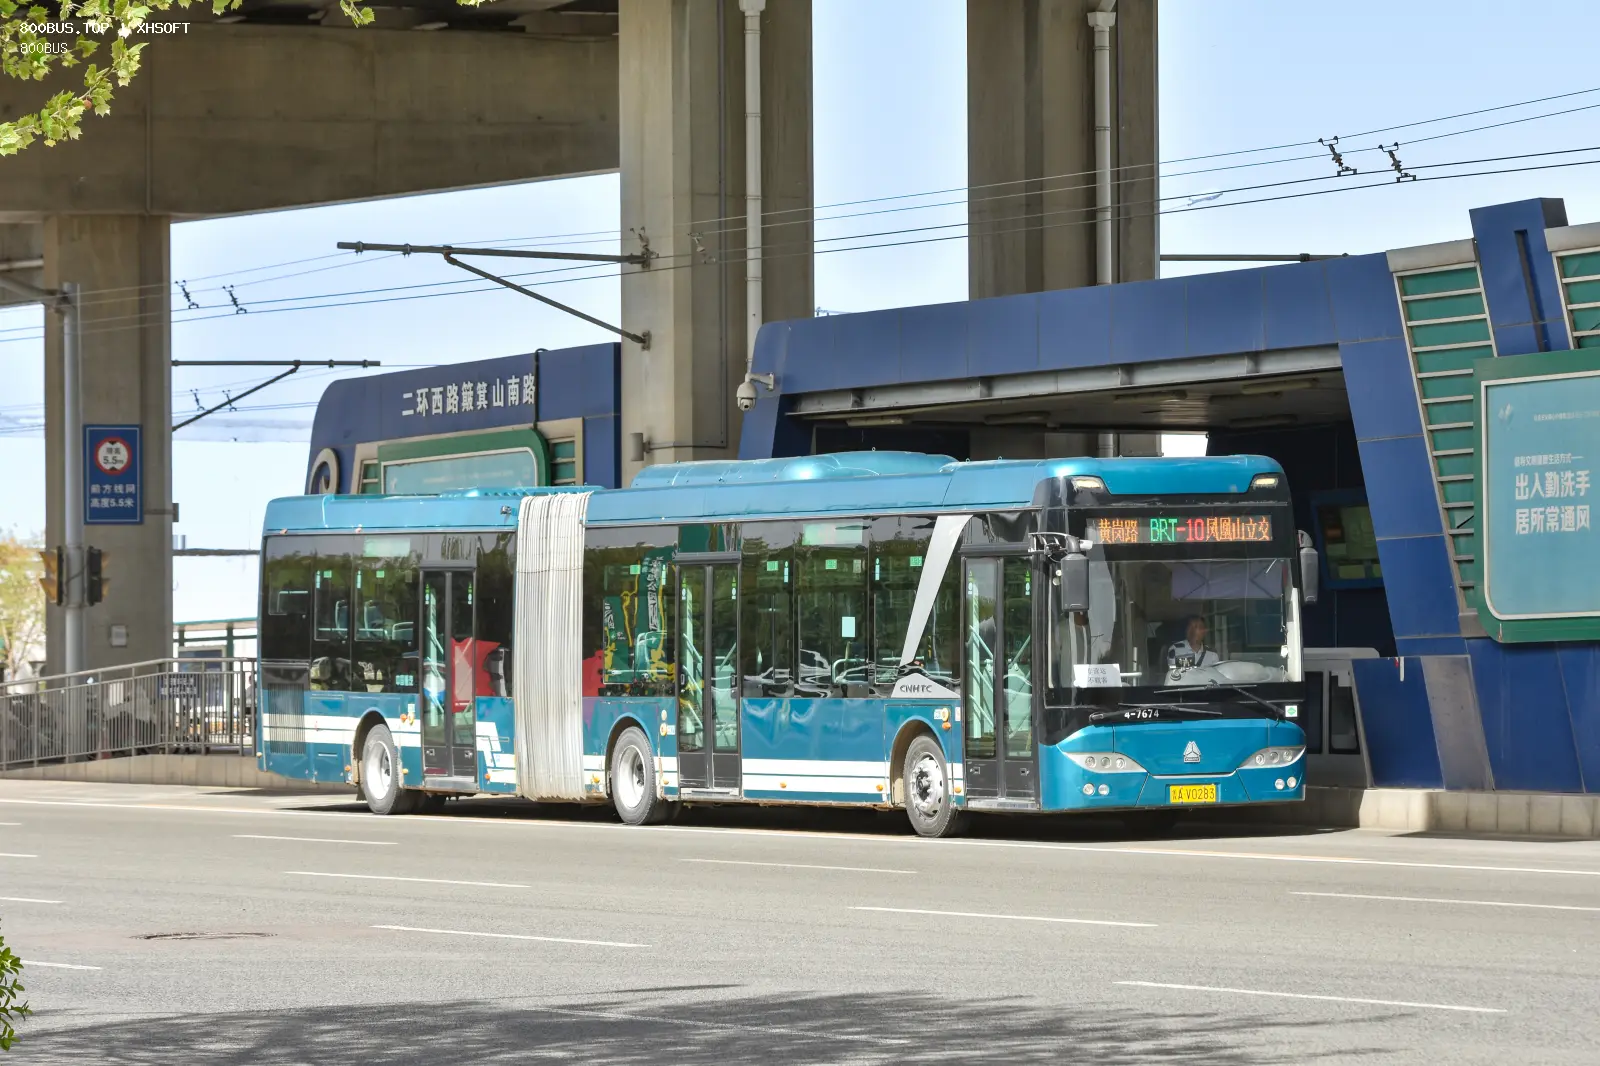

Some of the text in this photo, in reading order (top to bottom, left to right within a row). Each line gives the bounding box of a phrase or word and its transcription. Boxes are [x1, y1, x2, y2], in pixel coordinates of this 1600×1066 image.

[401, 373, 536, 417] 二环西路簸箕山南路
[90, 498, 134, 508] 高度5.5米
[1099, 516, 1271, 543] 黄岗路 BRT-10 凤凰山立交
[1515, 505, 1590, 535] 居所常通风
[900, 684, 933, 693] CNHTC
[1124, 708, 1160, 719] 4-7674
